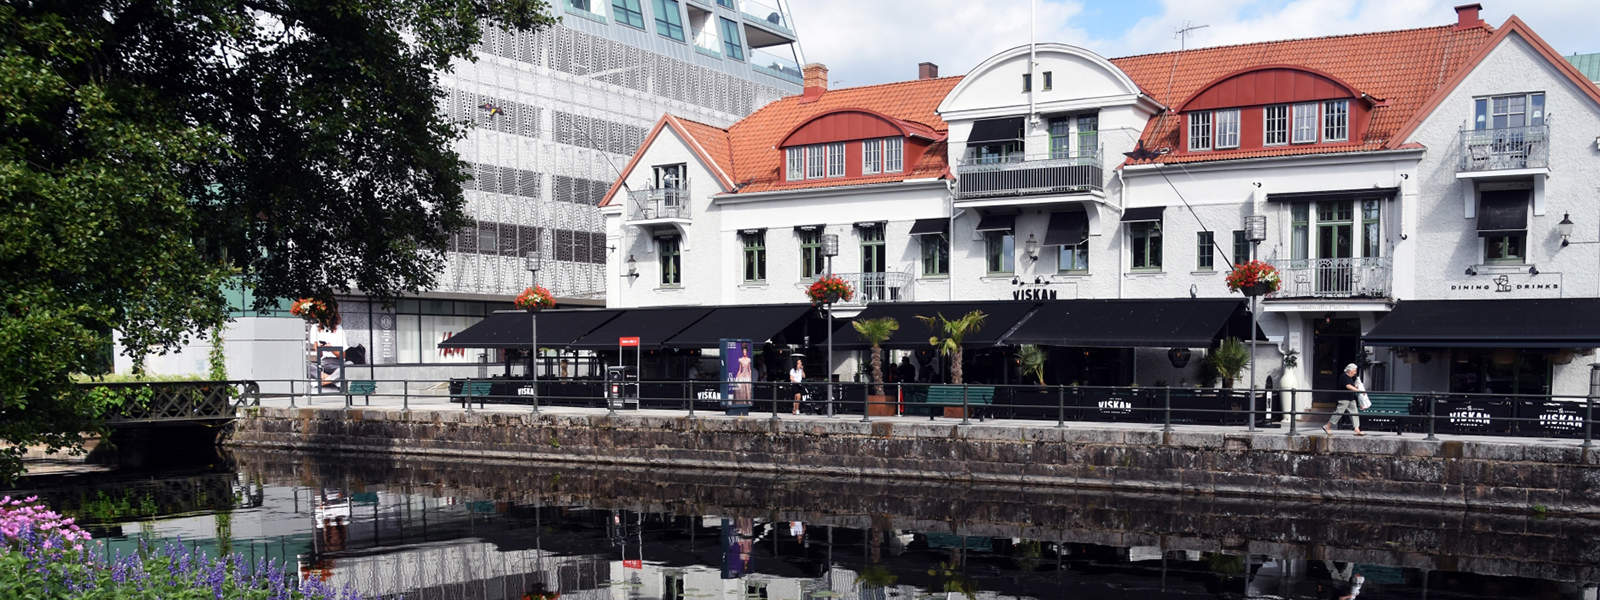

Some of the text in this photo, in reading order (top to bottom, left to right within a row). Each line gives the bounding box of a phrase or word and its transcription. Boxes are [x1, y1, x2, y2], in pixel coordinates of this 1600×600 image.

[1013, 289, 1057, 300] VISKAN
[517, 387, 534, 396] VISKA
[1098, 400, 1132, 412] VISKAN
[1449, 411, 1491, 424] VISKAN
[1539, 413, 1583, 428] VISKAN
